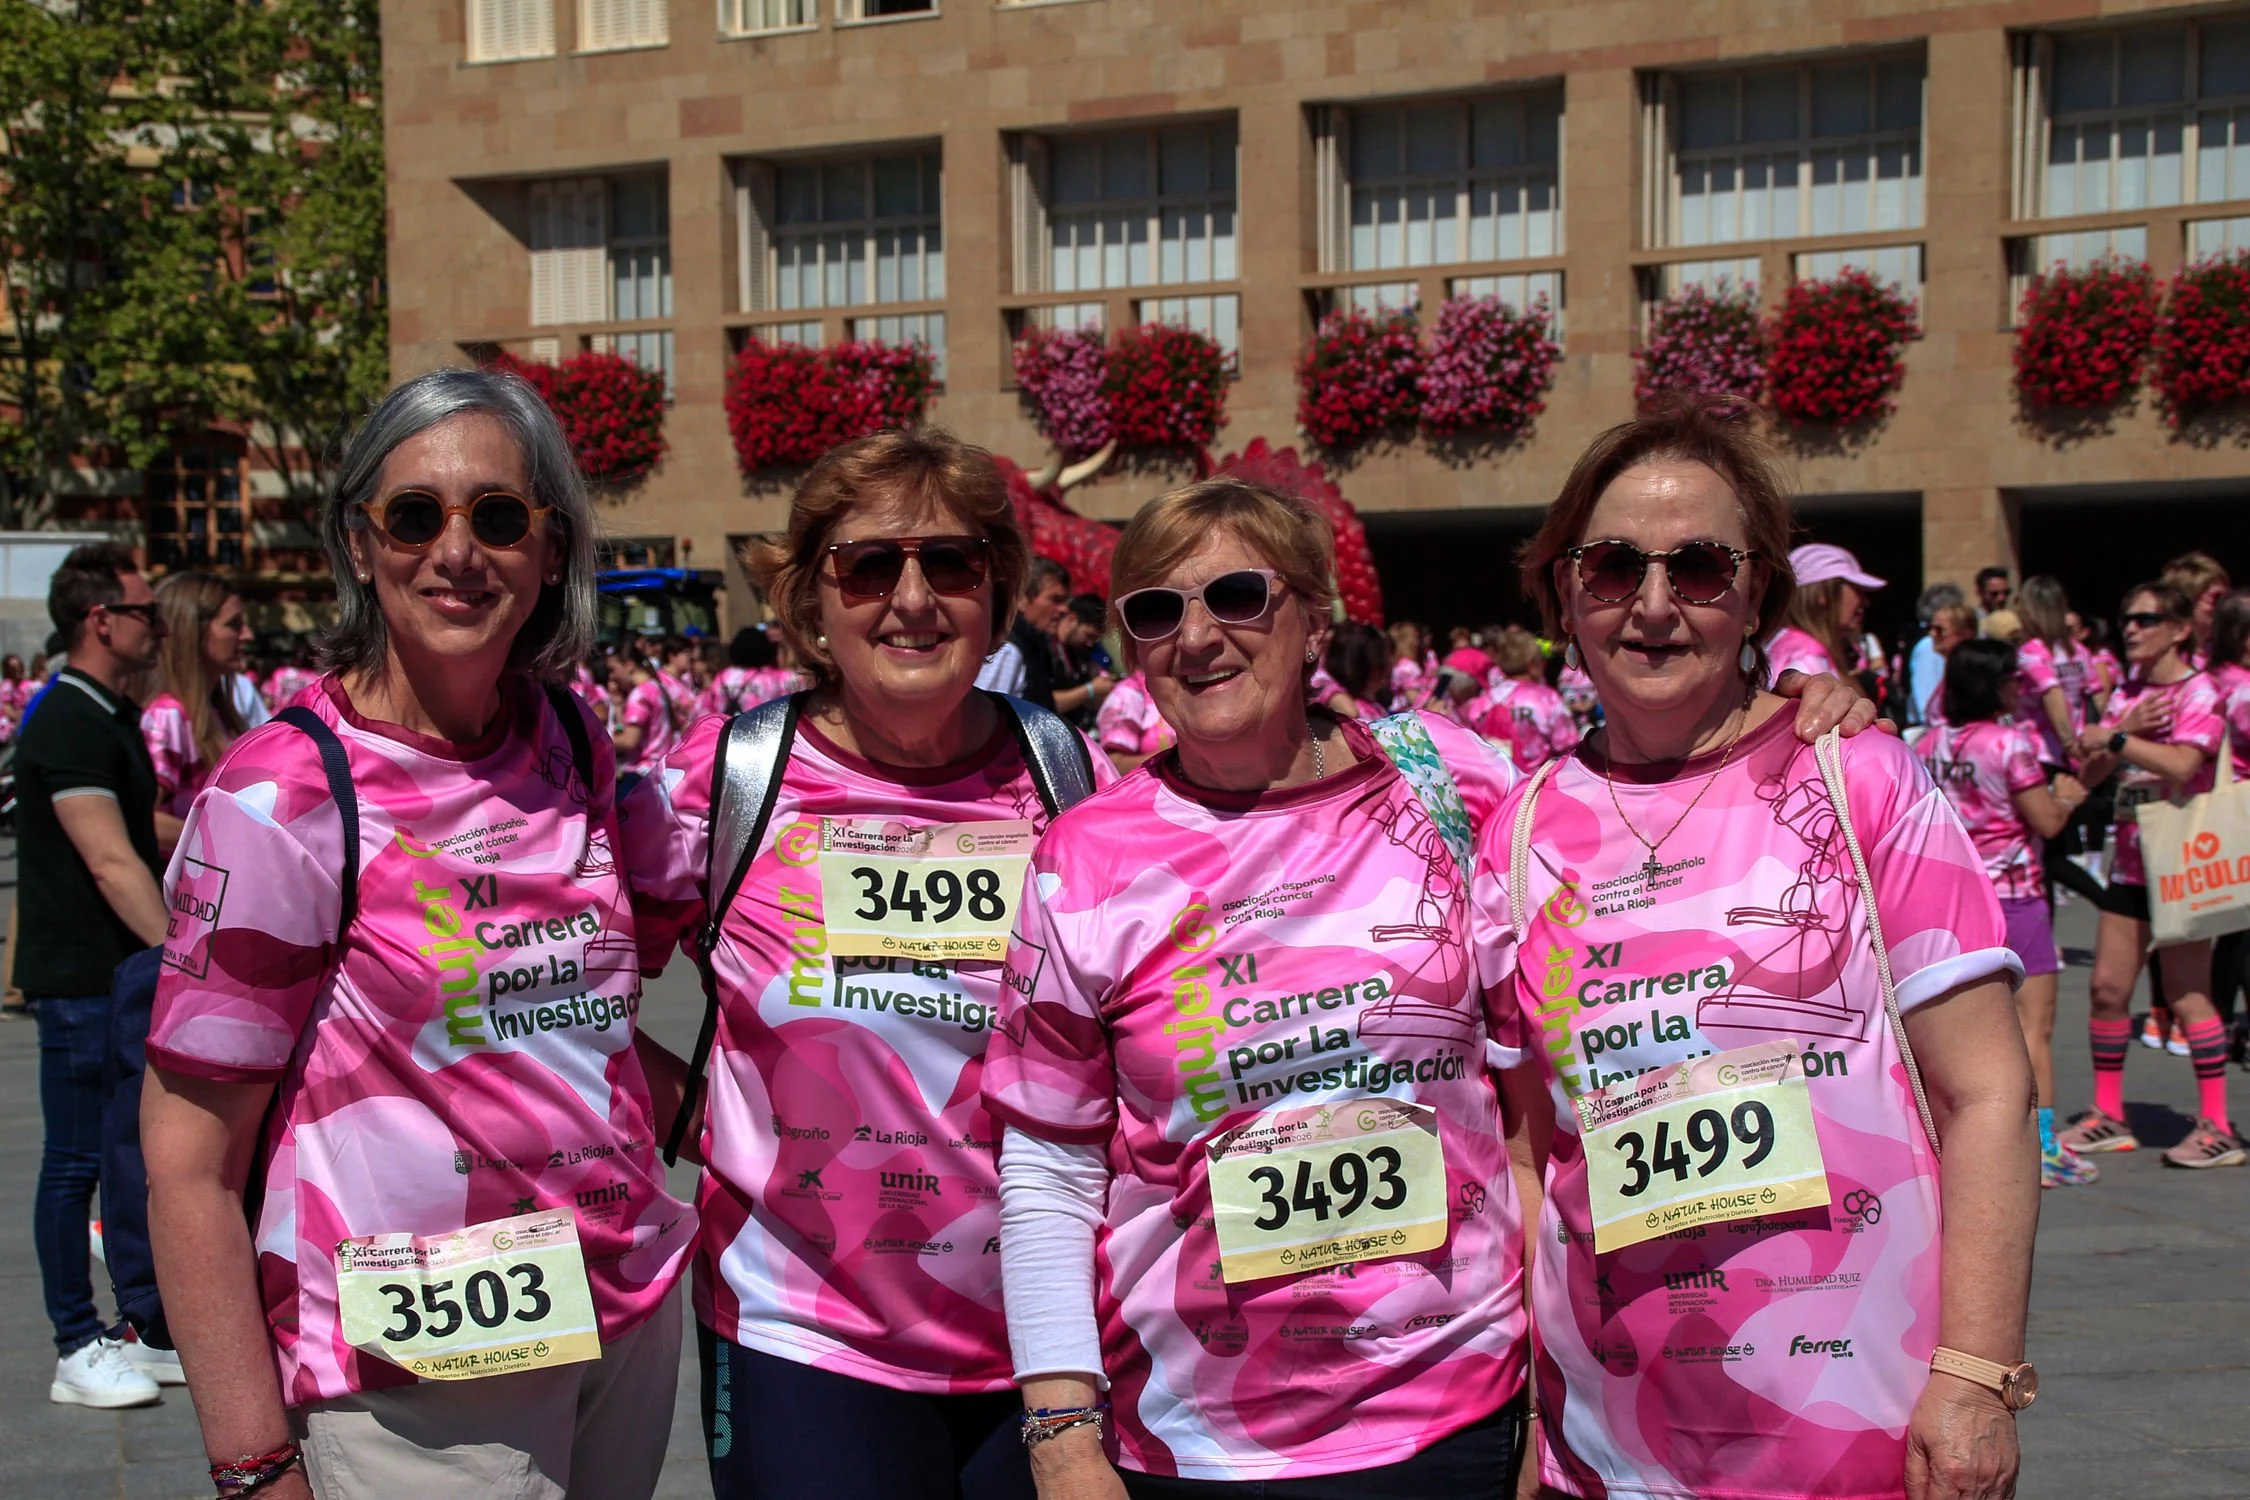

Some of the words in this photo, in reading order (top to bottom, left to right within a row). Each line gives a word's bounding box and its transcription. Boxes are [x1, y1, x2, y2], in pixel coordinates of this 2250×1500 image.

[474, 840, 484, 851] el
[832, 827, 845, 838] XI
[848, 830, 883, 841] Carrera
[885, 834, 901, 844] por
[473, 852, 501, 865] Rioja
[458, 874, 498, 911] XI
[851, 867, 1006, 923] 3498
[1592, 888, 1630, 903] contra
[1633, 884, 1643, 895] el
[1255, 907, 1285, 919] Rioja
[1594, 906, 1609, 917] en
[1610, 903, 1625, 914] La
[1627, 897, 1656, 910] Rioja
[474, 911, 601, 950] Carrera
[412, 880, 486, 1046] mujer
[1581, 942, 1623, 969] XI
[489, 963, 544, 1005] por
[549, 954, 578, 985] la
[1216, 953, 1258, 988] XI
[1577, 963, 1729, 1008] Carrera
[1222, 977, 1390, 1028] Carrera
[1579, 1018, 1643, 1064] por
[1651, 1008, 1691, 1043] la
[1227, 1034, 1301, 1079] por
[1309, 1025, 1351, 1053] la
[1236, 1049, 1468, 1105] Investigación
[1641, 1084, 1657, 1097] por
[1658, 1081, 1668, 1090] la
[1653, 1091, 1672, 1103] 2026
[876, 1130, 891, 1144] La
[895, 1131, 928, 1146] Rioja
[1278, 1123, 1295, 1134] por
[1297, 1121, 1308, 1130] la
[1291, 1133, 1312, 1142] 2026
[568, 1151, 582, 1164] La
[583, 1144, 615, 1160] Rioja
[1614, 1100, 1775, 1197] 3499
[1248, 1146, 1407, 1231] 3493
[1663, 1202, 1706, 1223] NATUR
[1710, 1194, 1756, 1210] HOUSE
[1665, 1220, 1688, 1231] Expertos
[1299, 1242, 1342, 1261] NATUR
[1779, 1275, 1837, 1286] HUMILDAD
[1840, 1273, 1861, 1284] RUIZ
[378, 1262, 552, 1343] 3503
[431, 1355, 480, 1373] NATUR
[483, 1347, 530, 1365] HOUSE
[470, 1367, 498, 1376] Nutrición
[504, 1362, 531, 1370] Dietética
